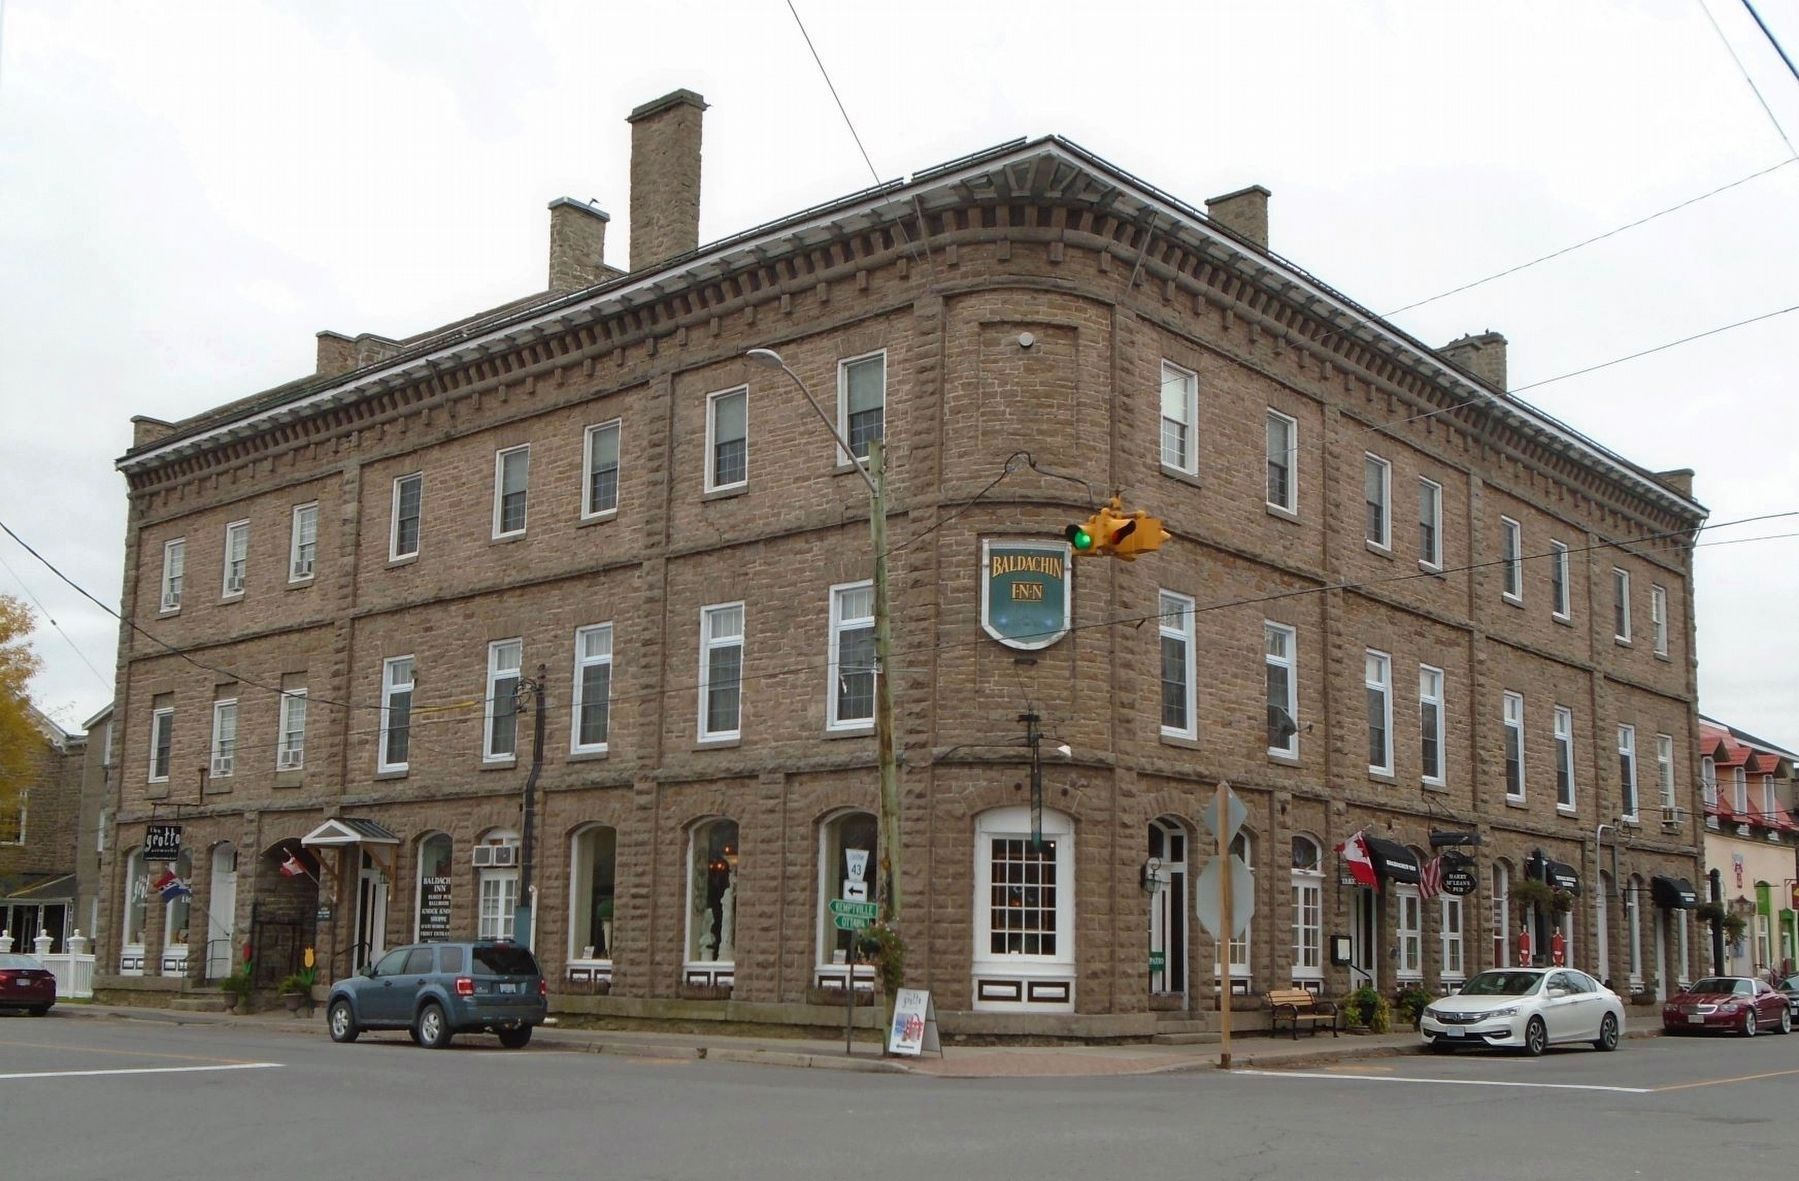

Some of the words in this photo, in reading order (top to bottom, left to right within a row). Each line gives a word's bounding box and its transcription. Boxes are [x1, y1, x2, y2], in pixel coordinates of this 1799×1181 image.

[992, 555, 1063, 580] BALDACHIN
[144, 827, 180, 852] grotto
[851, 863, 862, 876] 43
[433, 885, 447, 893] INN
[835, 901, 874, 917] KEMPTVILLE
